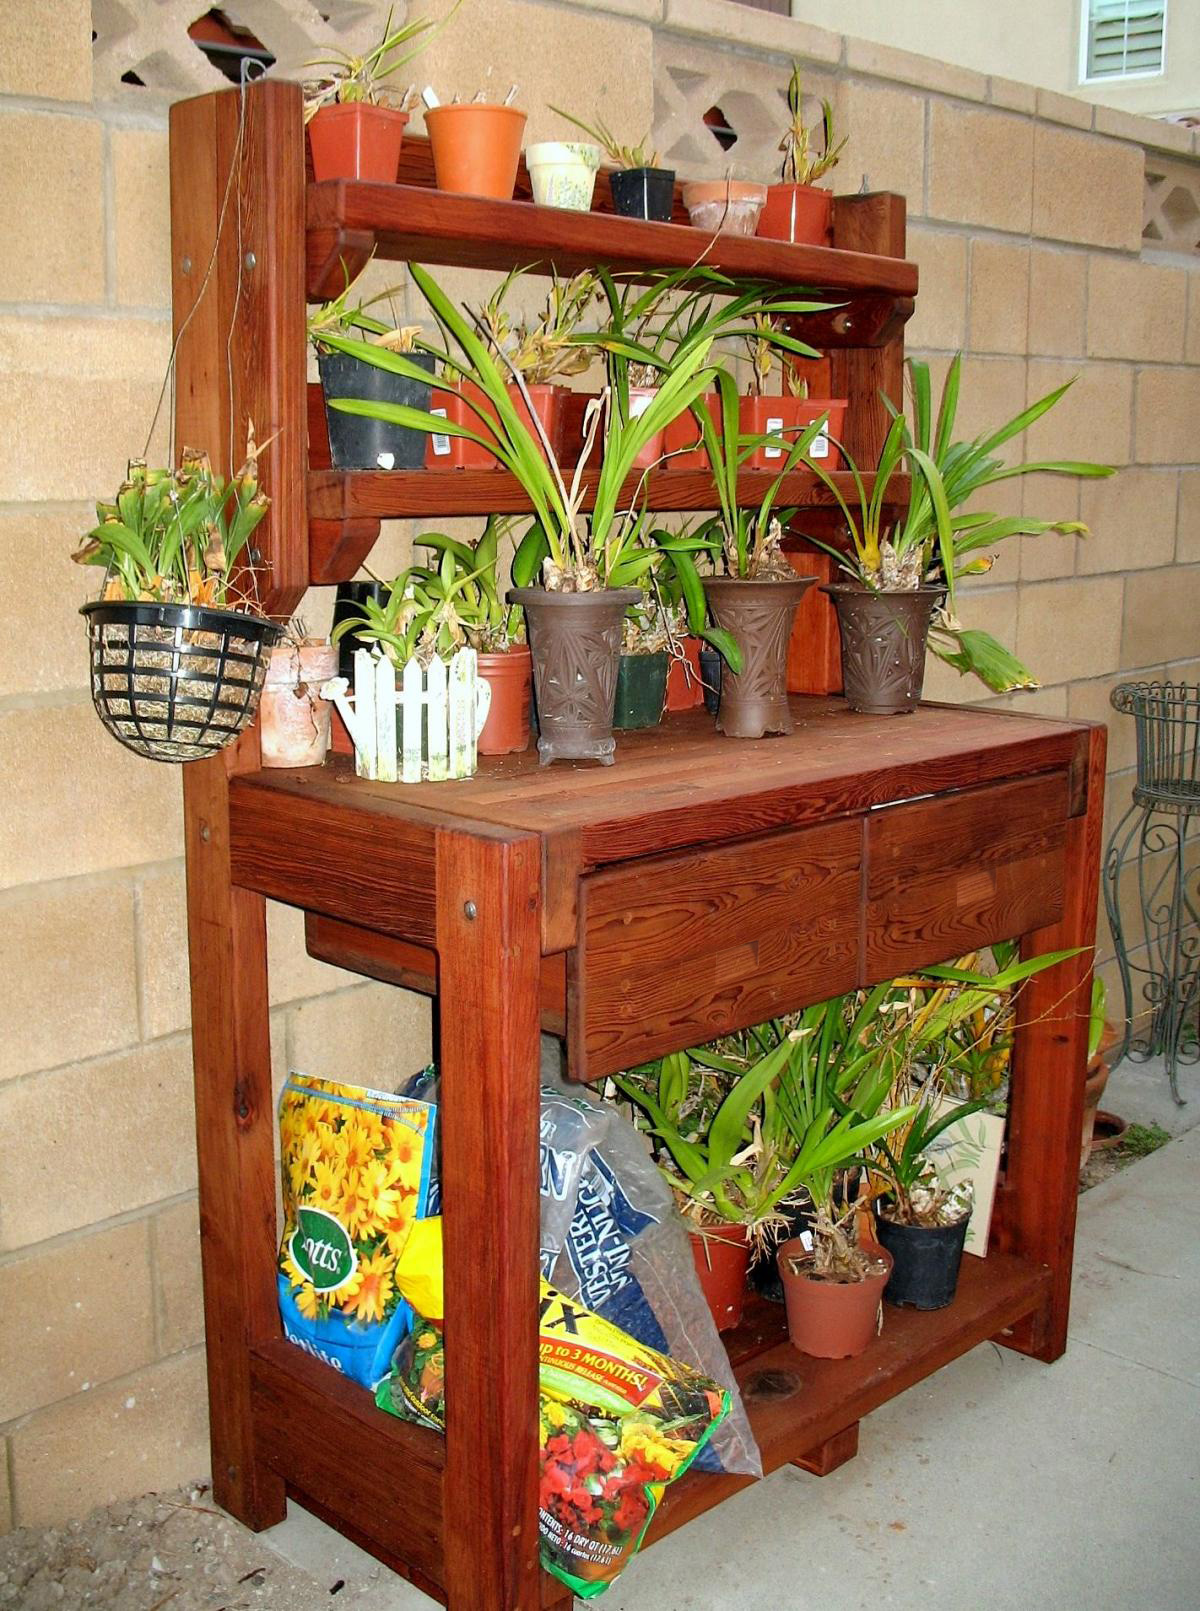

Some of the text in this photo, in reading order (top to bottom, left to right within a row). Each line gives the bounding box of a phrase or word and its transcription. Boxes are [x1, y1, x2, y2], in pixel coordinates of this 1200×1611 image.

[555, 1346, 570, 1357] to
[570, 1349, 582, 1360] 3
[581, 1352, 648, 1387] MONTHS!
[563, 1542, 571, 1551] 16
[564, 1529, 574, 1541] 16
[574, 1534, 590, 1548] DRY
